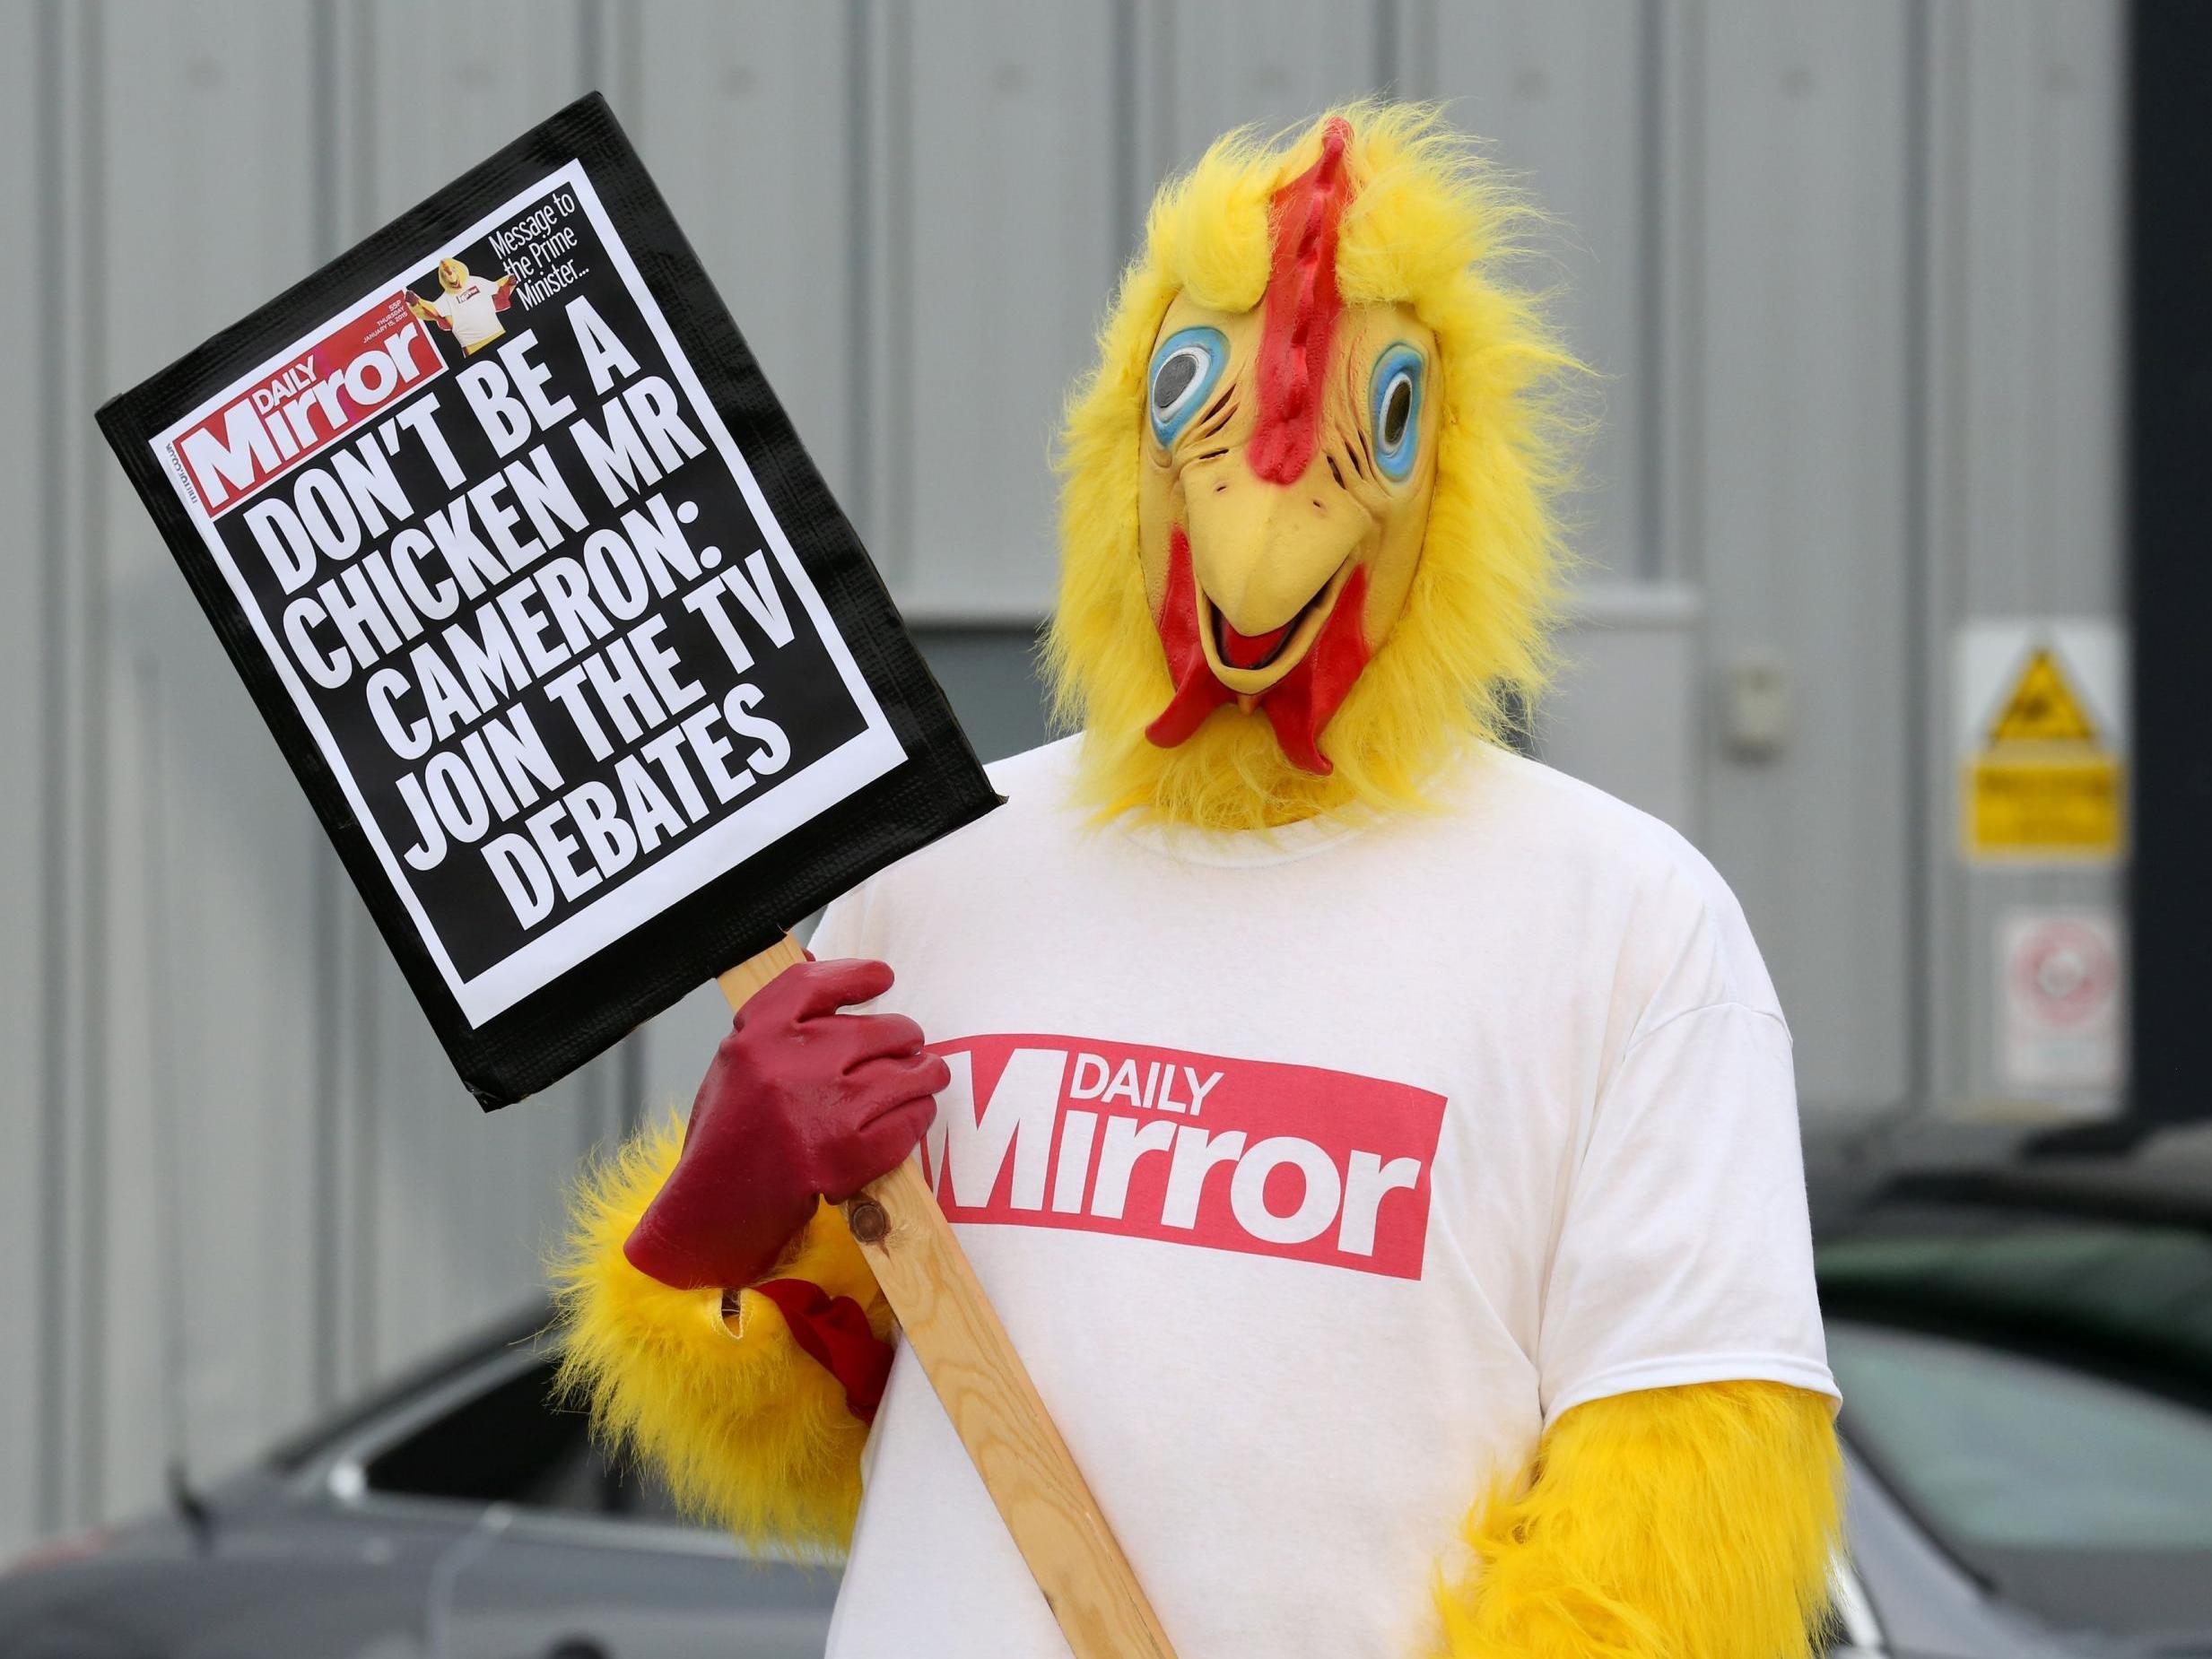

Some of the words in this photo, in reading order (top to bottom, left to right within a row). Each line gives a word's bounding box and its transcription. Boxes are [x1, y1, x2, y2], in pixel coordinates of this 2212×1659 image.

[488, 205, 558, 260] Message
[552, 193, 576, 217] to
[502, 256, 535, 284] the
[528, 227, 578, 268] Prime
[516, 259, 589, 311] Minister...
[362, 323, 388, 344] JANUARY
[377, 306, 405, 326] THURSDAY
[180, 322, 421, 508] Mirror
[243, 392, 466, 595] DON'T
[456, 329, 577, 458] BE
[565, 295, 640, 395] A
[252, 355, 317, 415] DAILY
[283, 444, 589, 689] CHICKEN
[569, 377, 707, 508] MR
[367, 493, 721, 760] CAMERON:
[396, 702, 564, 871] JOIN
[544, 613, 706, 761] THE
[682, 549, 795, 673] TV
[481, 683, 790, 930] DEBATES
[1070, 1053, 1224, 1116] DAILY
[929, 1048, 1422, 1257] Mirror
